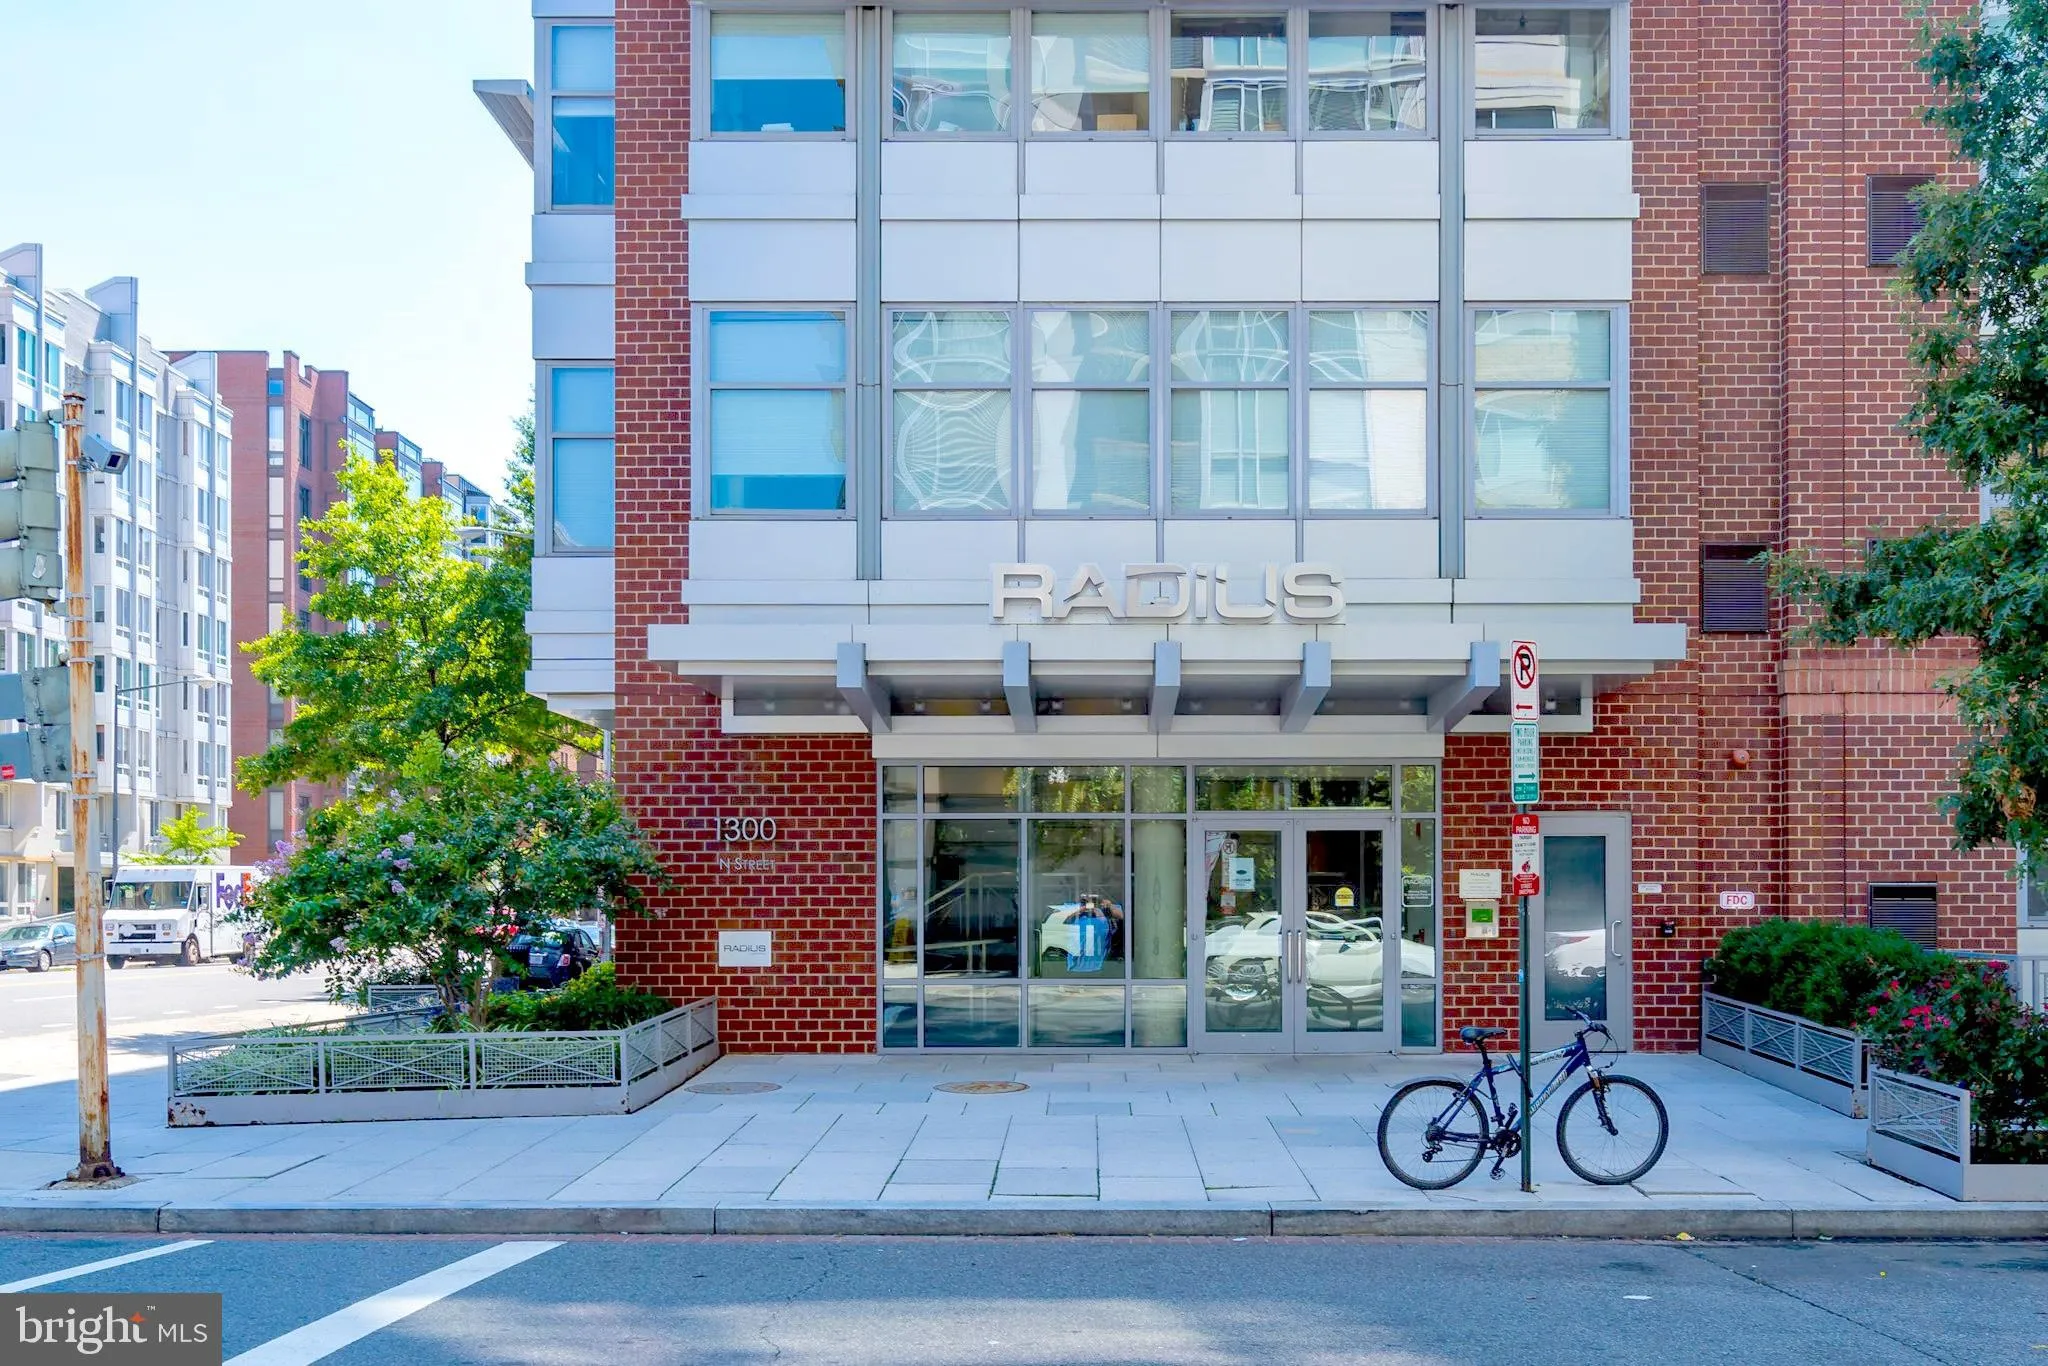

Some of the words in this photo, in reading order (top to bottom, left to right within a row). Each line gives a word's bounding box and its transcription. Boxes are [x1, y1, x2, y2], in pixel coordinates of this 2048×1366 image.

[992, 564, 1345, 623] RADIUS
[1522, 816, 1530, 825] NO
[714, 817, 777, 841] 1300
[1515, 825, 1536, 834] PARKING
[719, 858, 730, 871] N
[735, 857, 777, 871] STREET
[216, 872, 252, 909] FedE
[1726, 895, 1748, 905] FDC
[723, 944, 767, 952] RADIUS
